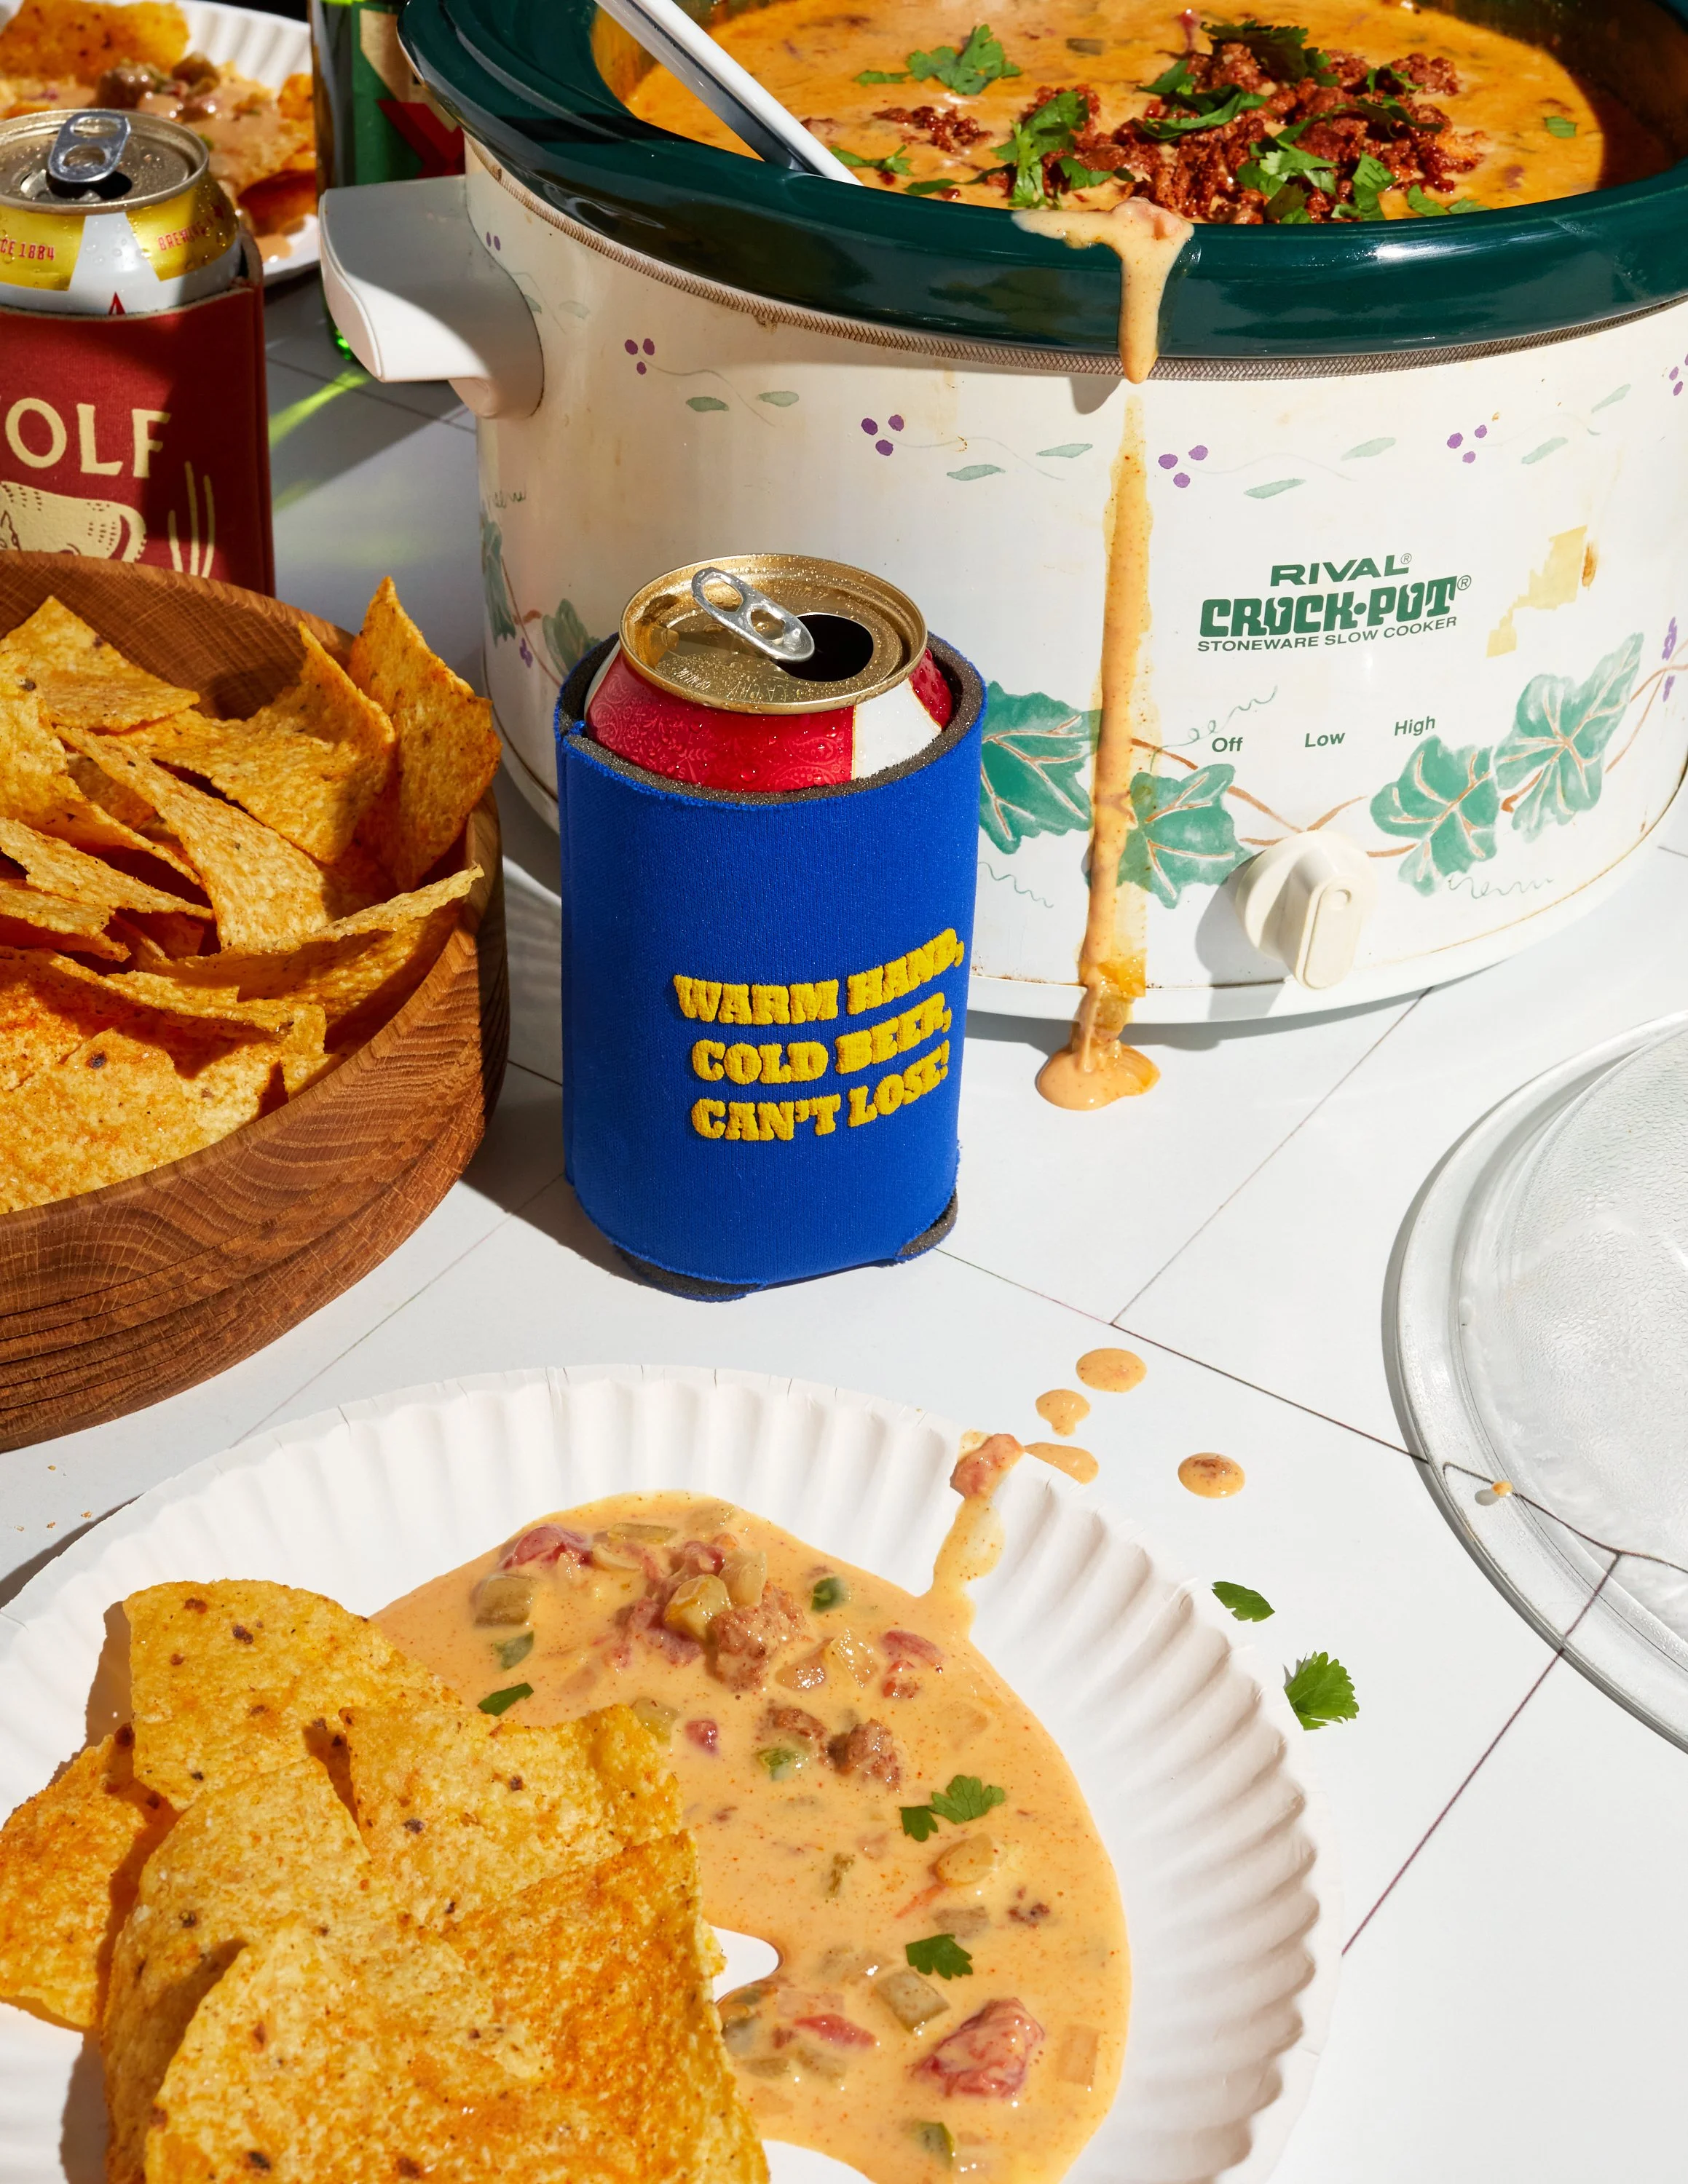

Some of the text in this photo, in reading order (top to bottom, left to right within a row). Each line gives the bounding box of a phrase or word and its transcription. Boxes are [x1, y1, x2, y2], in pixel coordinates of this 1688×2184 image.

[0, 238, 55, 261] CE 1884
[0, 397, 171, 478] OLF
[1197, 617, 1457, 652] STONEWARE SLOW COOKER
[1305, 732, 1346, 748] Low
[1395, 716, 1435, 736] High
[1212, 737, 1243, 753] Off
[673, 927, 965, 1025] WARM HAND,
[691, 992, 953, 1085] COLD BEER,
[691, 1039, 950, 1141] CAN'T LOSE!
